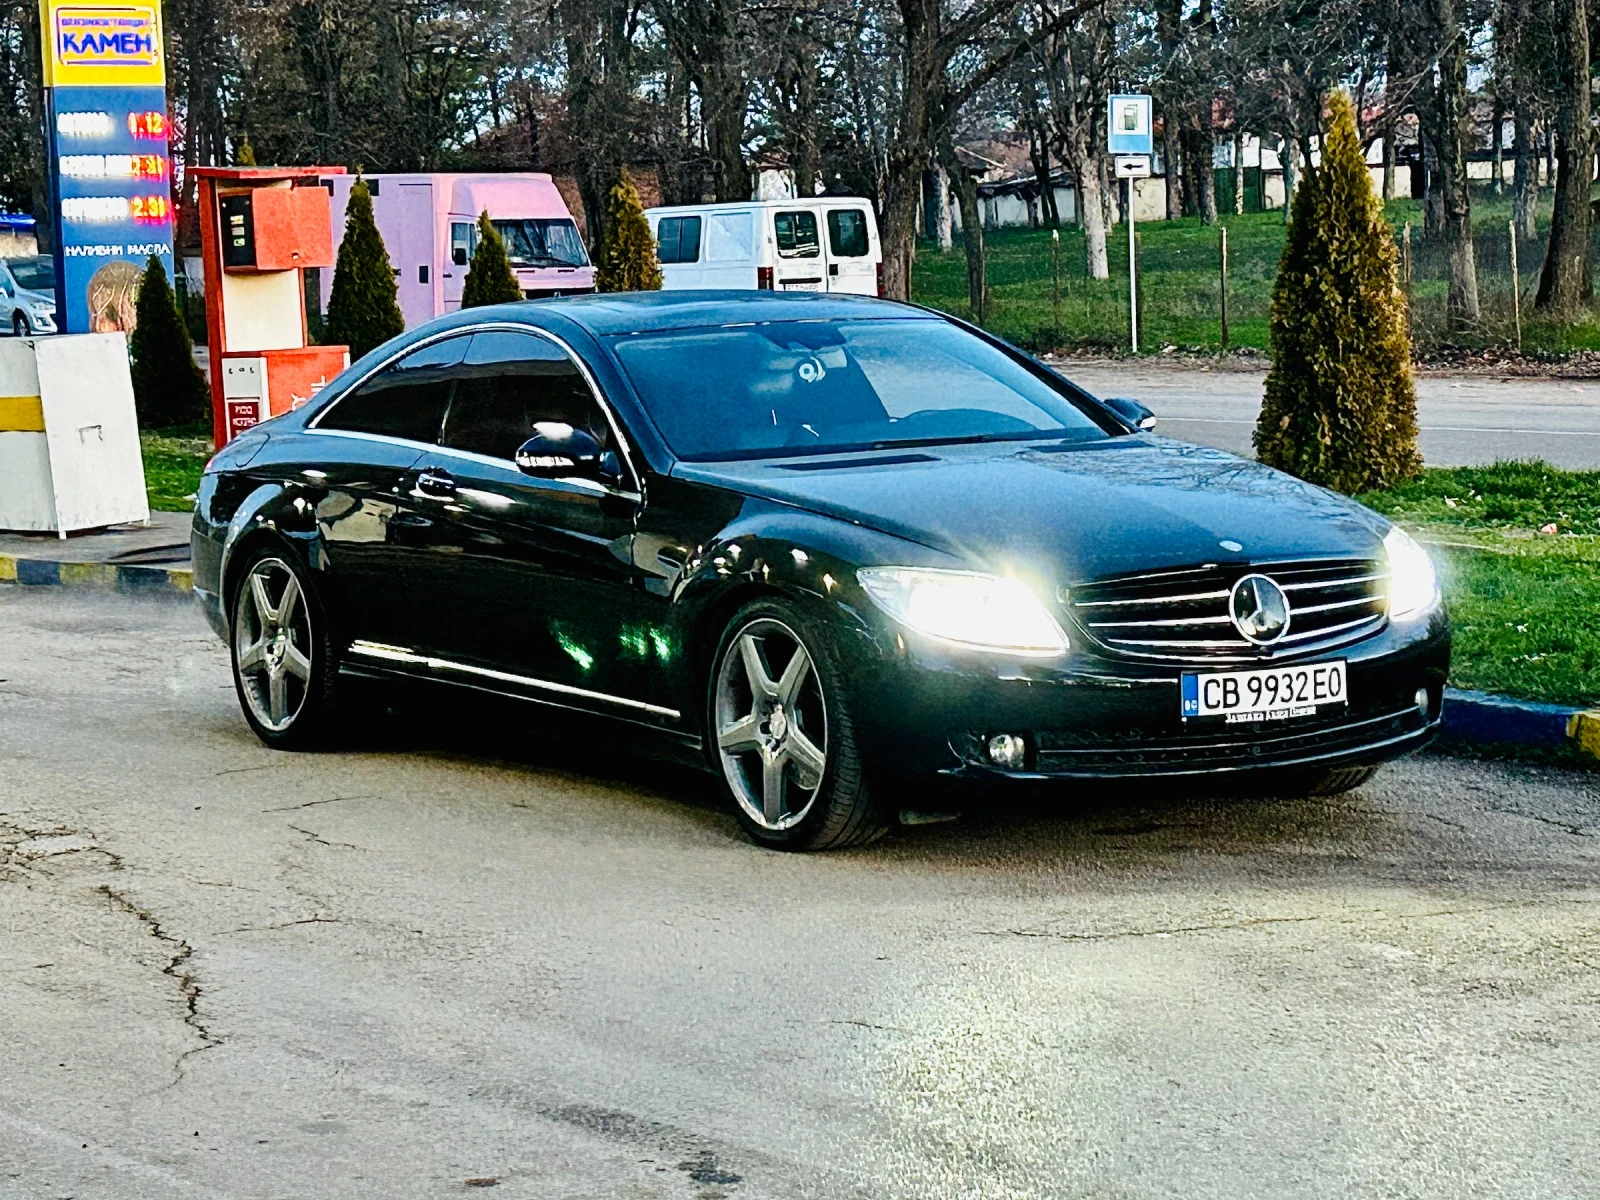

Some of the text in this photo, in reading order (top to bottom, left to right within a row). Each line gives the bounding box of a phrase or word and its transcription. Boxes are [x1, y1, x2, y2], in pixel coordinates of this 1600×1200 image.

[62, 32, 152, 54] КАМЕН
[1203, 677, 1241, 709] CB
[1247, 671, 1309, 707] 9932
